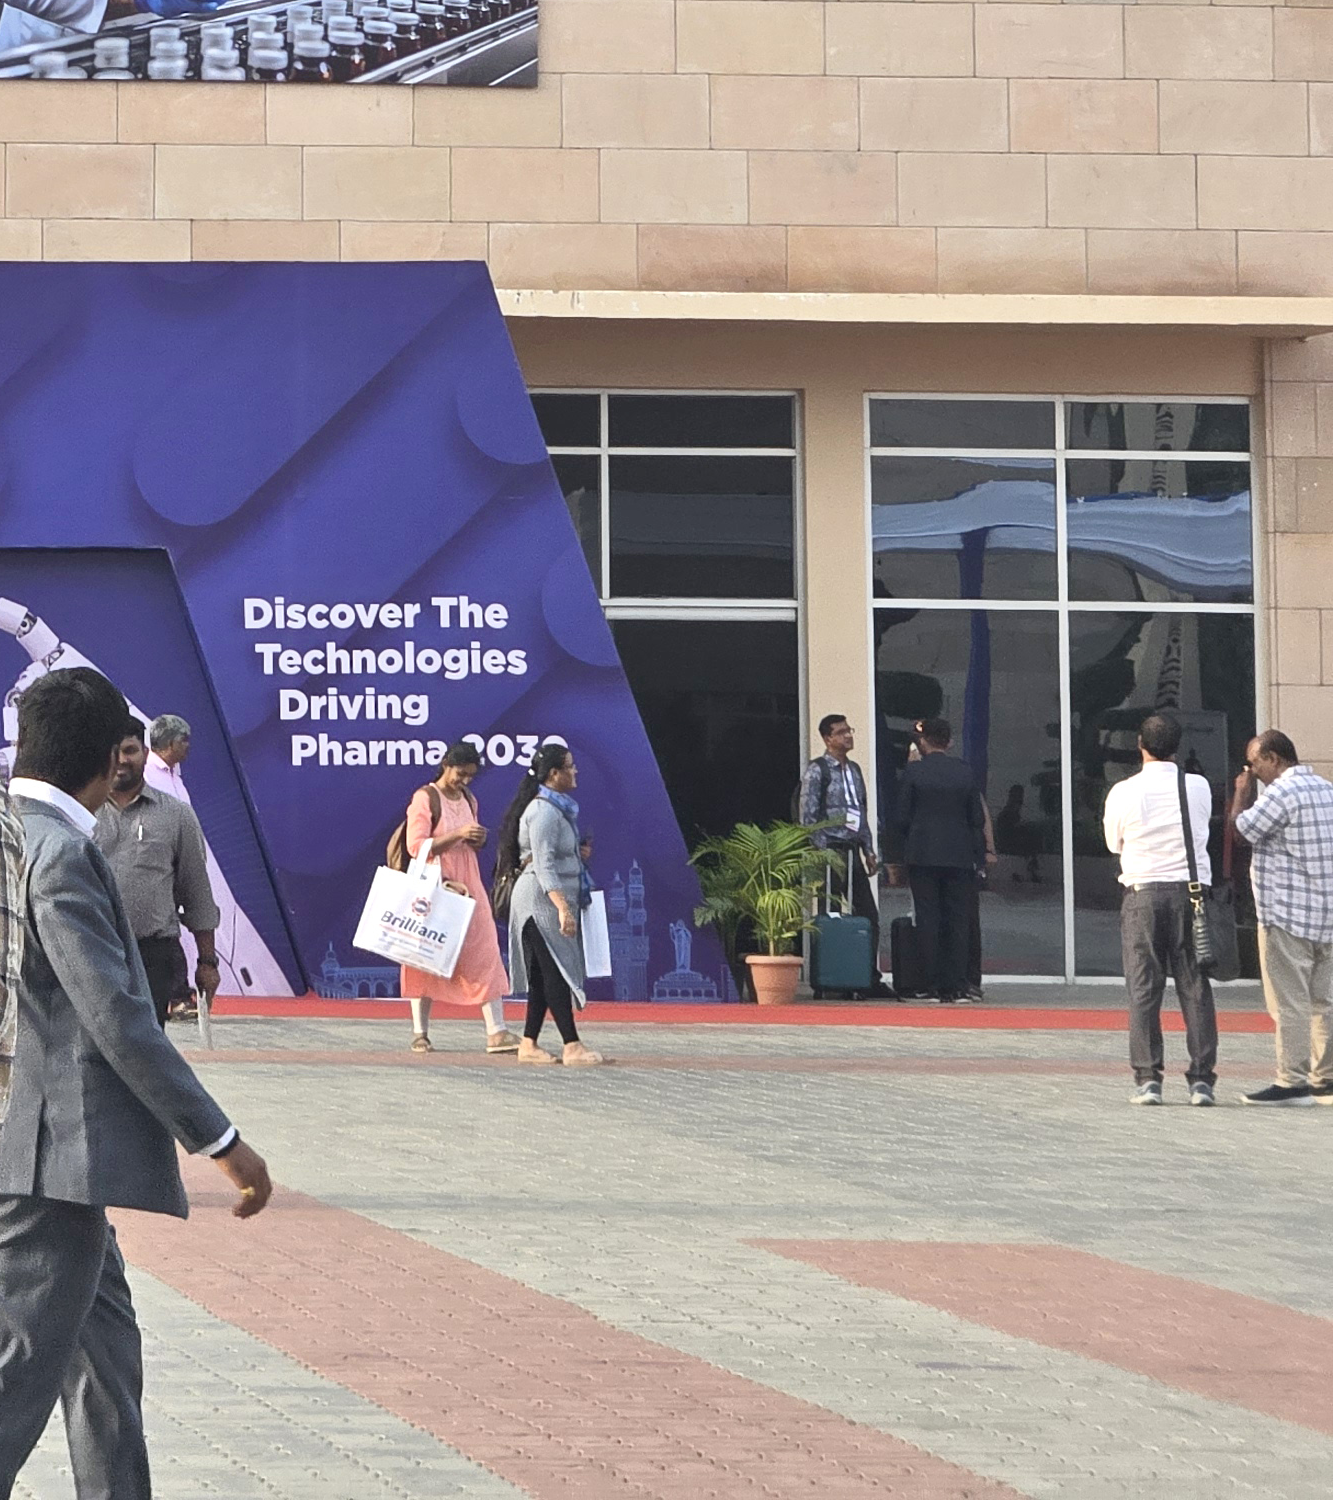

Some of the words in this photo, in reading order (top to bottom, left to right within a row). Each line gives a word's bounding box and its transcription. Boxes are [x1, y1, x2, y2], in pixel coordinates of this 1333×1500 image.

[244, 597, 420, 628] Discover
[432, 596, 508, 628] The
[255, 641, 527, 680] Technologies
[280, 687, 428, 725] Driving
[291, 734, 447, 766] Pharma
[381, 911, 447, 944] Brilliant
